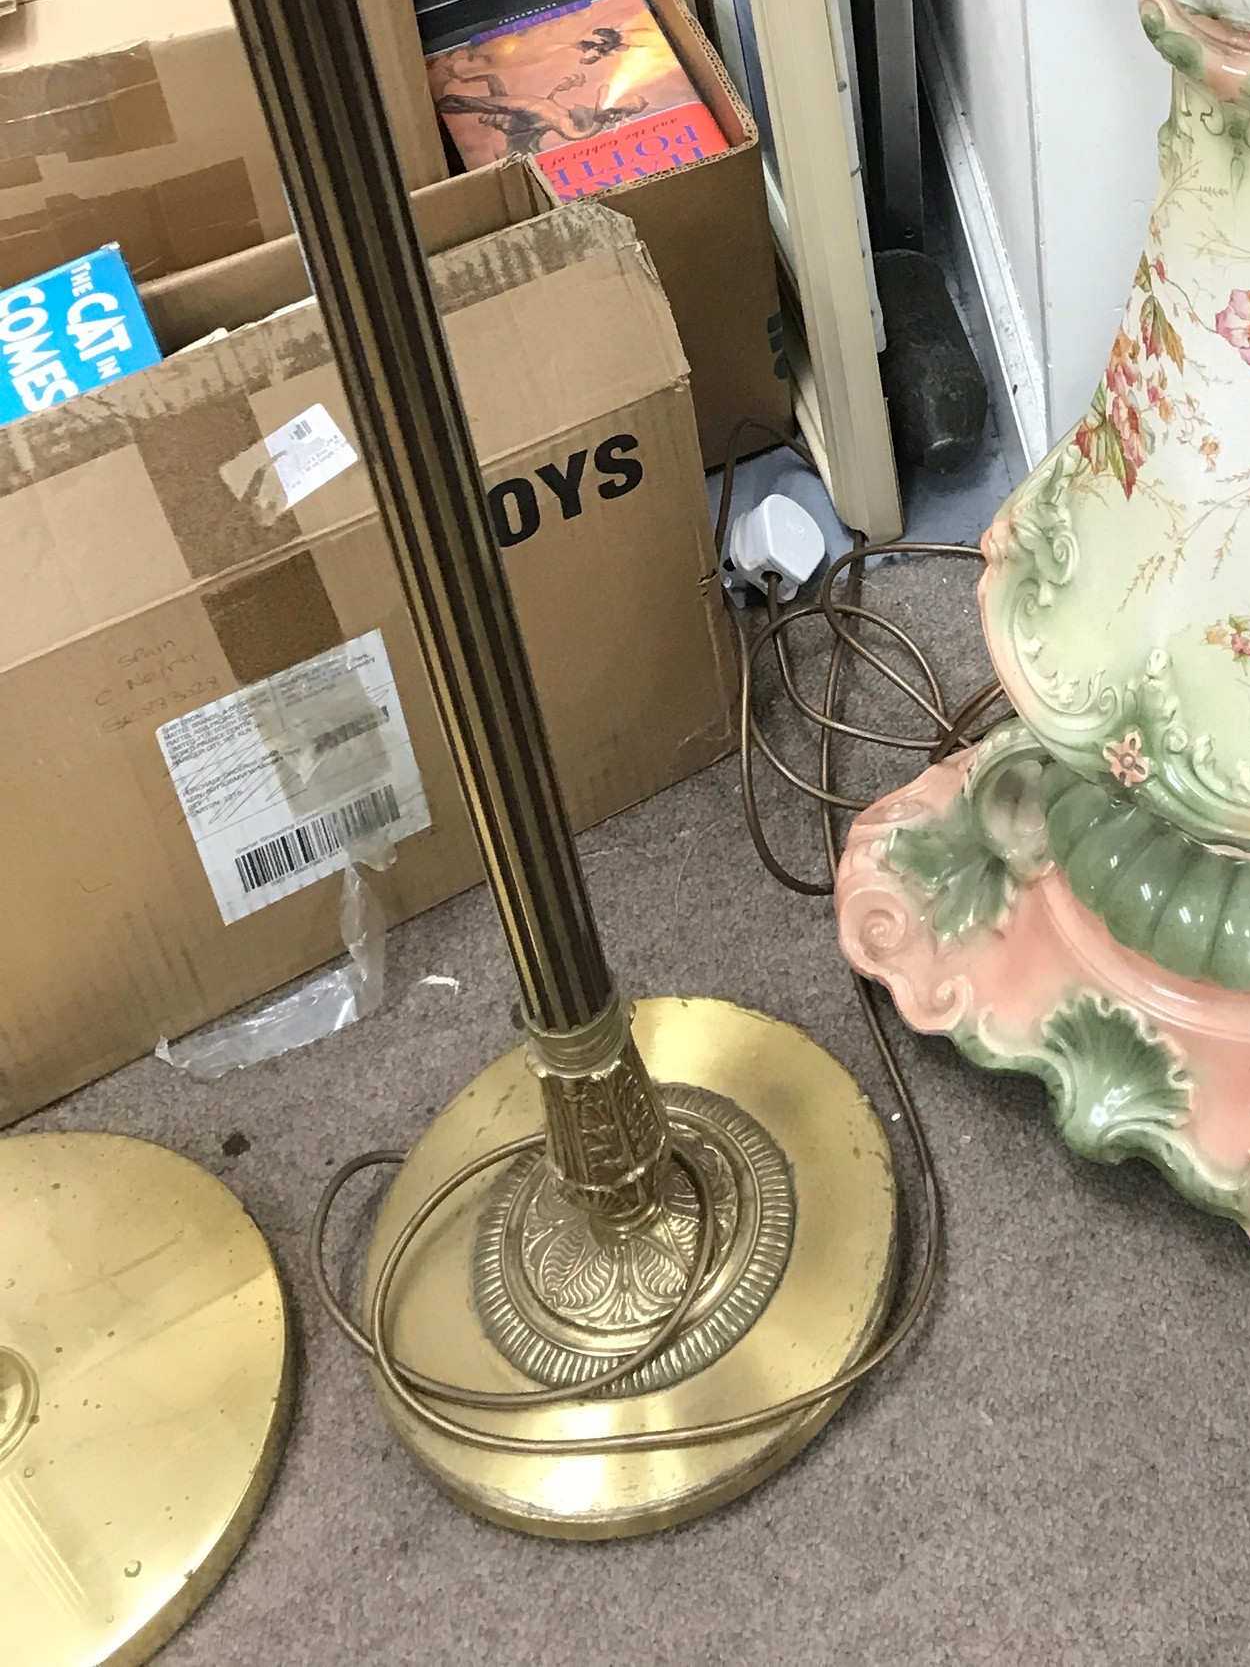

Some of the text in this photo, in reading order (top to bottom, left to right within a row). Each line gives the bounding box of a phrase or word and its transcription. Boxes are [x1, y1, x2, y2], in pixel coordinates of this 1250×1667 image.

[624, 127, 644, 141] the
[571, 138, 618, 159] Goblet
[67, 262, 132, 379] THE CAT IN
[0, 287, 78, 412] COMES
[259, 822, 295, 844] Shipping
